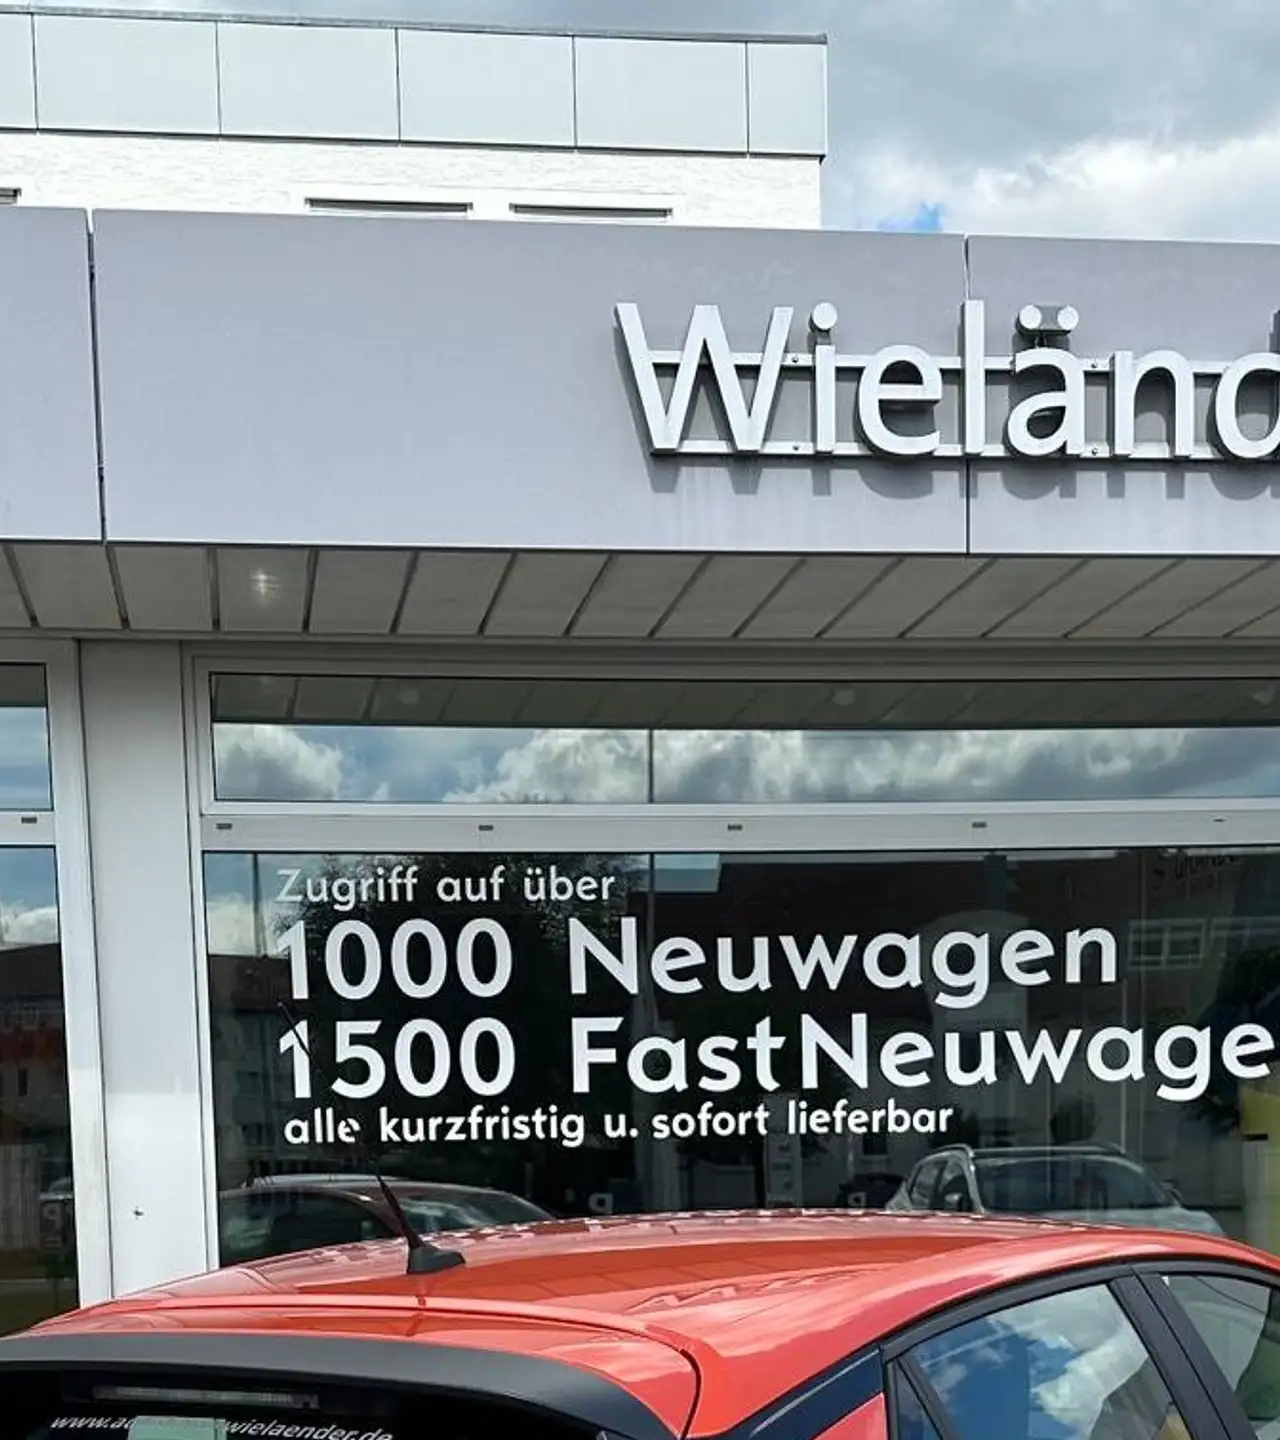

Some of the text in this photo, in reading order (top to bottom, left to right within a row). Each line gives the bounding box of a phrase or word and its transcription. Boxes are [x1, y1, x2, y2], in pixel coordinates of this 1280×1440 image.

[274, 864, 616, 912] Zugriff auf über
[276, 916, 1117, 1009] 1000 Neuwagen
[279, 1017, 516, 1100] 1500
[284, 1096, 955, 1148] alle kurzfristig u. sofort lieferbar
